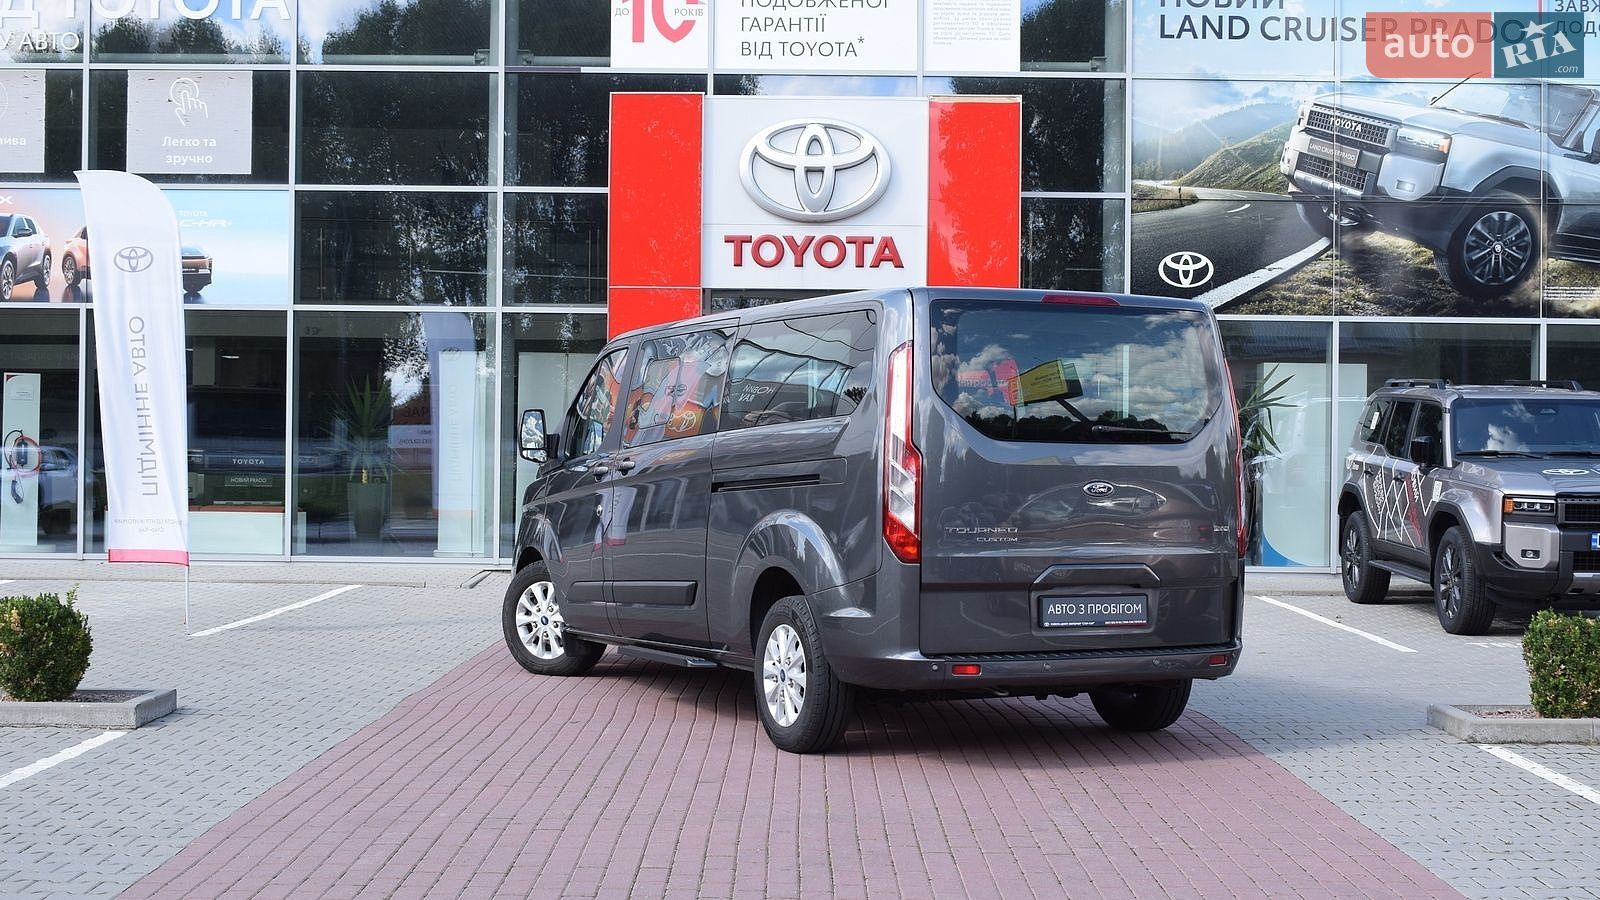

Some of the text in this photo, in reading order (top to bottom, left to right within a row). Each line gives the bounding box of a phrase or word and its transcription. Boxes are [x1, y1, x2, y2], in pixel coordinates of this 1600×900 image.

[614, 7, 630, 17] ДО
[674, 8, 704, 17] РОКІВ
[741, 13, 827, 32] ГАРАНТІЇ
[1159, 14, 1526, 44] LAND CRUISER PRADO
[1554, 20, 1600, 37] ДОД
[18, 31, 81, 51] АВТО
[741, 41, 773, 60] ВІД
[1330, 117, 1362, 132] TOYOTA
[161, 136, 217, 147] Легко та
[166, 155, 213, 166] зручно
[723, 233, 904, 269] TOYOTA
[1047, 603, 1142, 615] АВТО З ПРОБІГОМ
